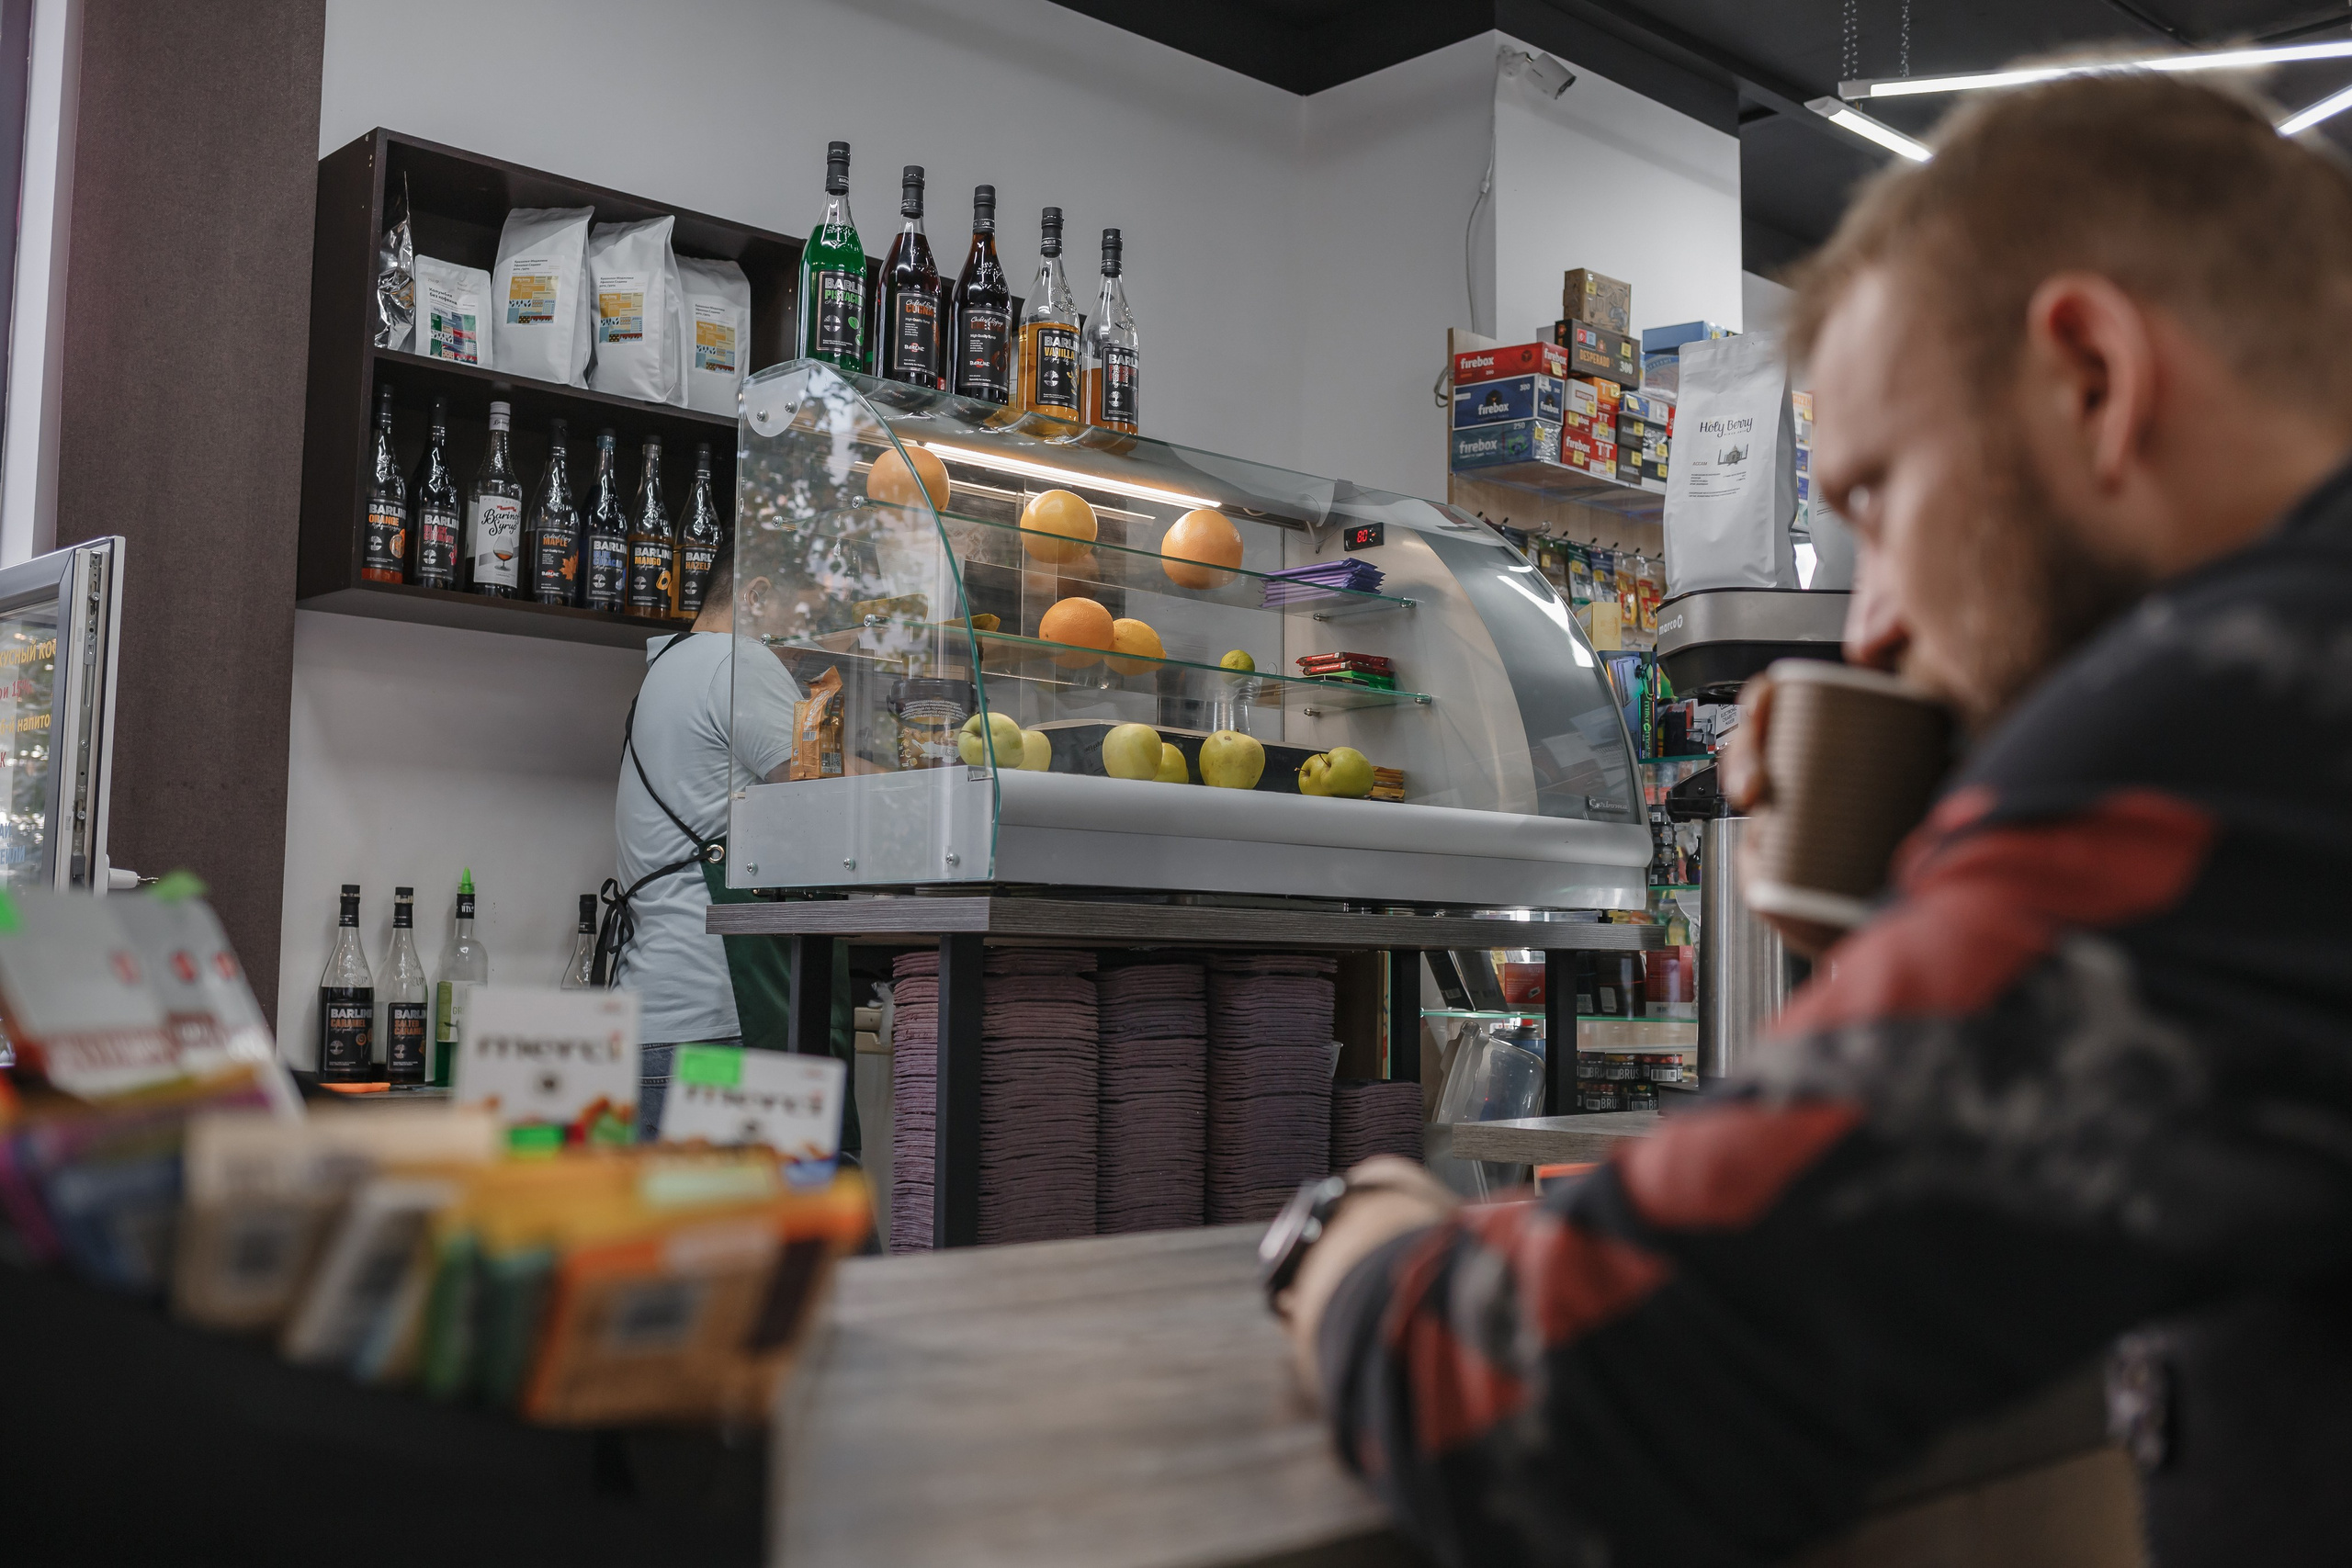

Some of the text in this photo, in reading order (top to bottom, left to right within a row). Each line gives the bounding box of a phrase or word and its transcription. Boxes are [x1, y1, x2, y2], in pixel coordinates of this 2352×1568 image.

[1044, 346, 1075, 360] VANILLA
[1544, 348, 1567, 365] firebox
[1460, 355, 1495, 369] firebox
[1619, 360, 1634, 375] 300
[1477, 402, 1509, 415] firebox
[1540, 400, 1559, 414] firebox
[1700, 417, 1753, 438] Holy Berry
[1459, 438, 1498, 454] firebox
[1566, 436, 1590, 453] firebox
[1596, 441, 1613, 458] TT
[368, 514, 399, 526] ORANGE
[488, 519, 517, 536] Syrup
[542, 537, 568, 547] MAPLE
[634, 556, 662, 566] MANGO
[1658, 618, 1678, 635] marco
[1720, 706, 1737, 718] ELECTRONIC
[1722, 712, 1737, 723] CIGARETTE
[17, 714, 51, 733] напито
[331, 1019, 366, 1028] CARAMEL
[475, 1029, 625, 1066] merci
